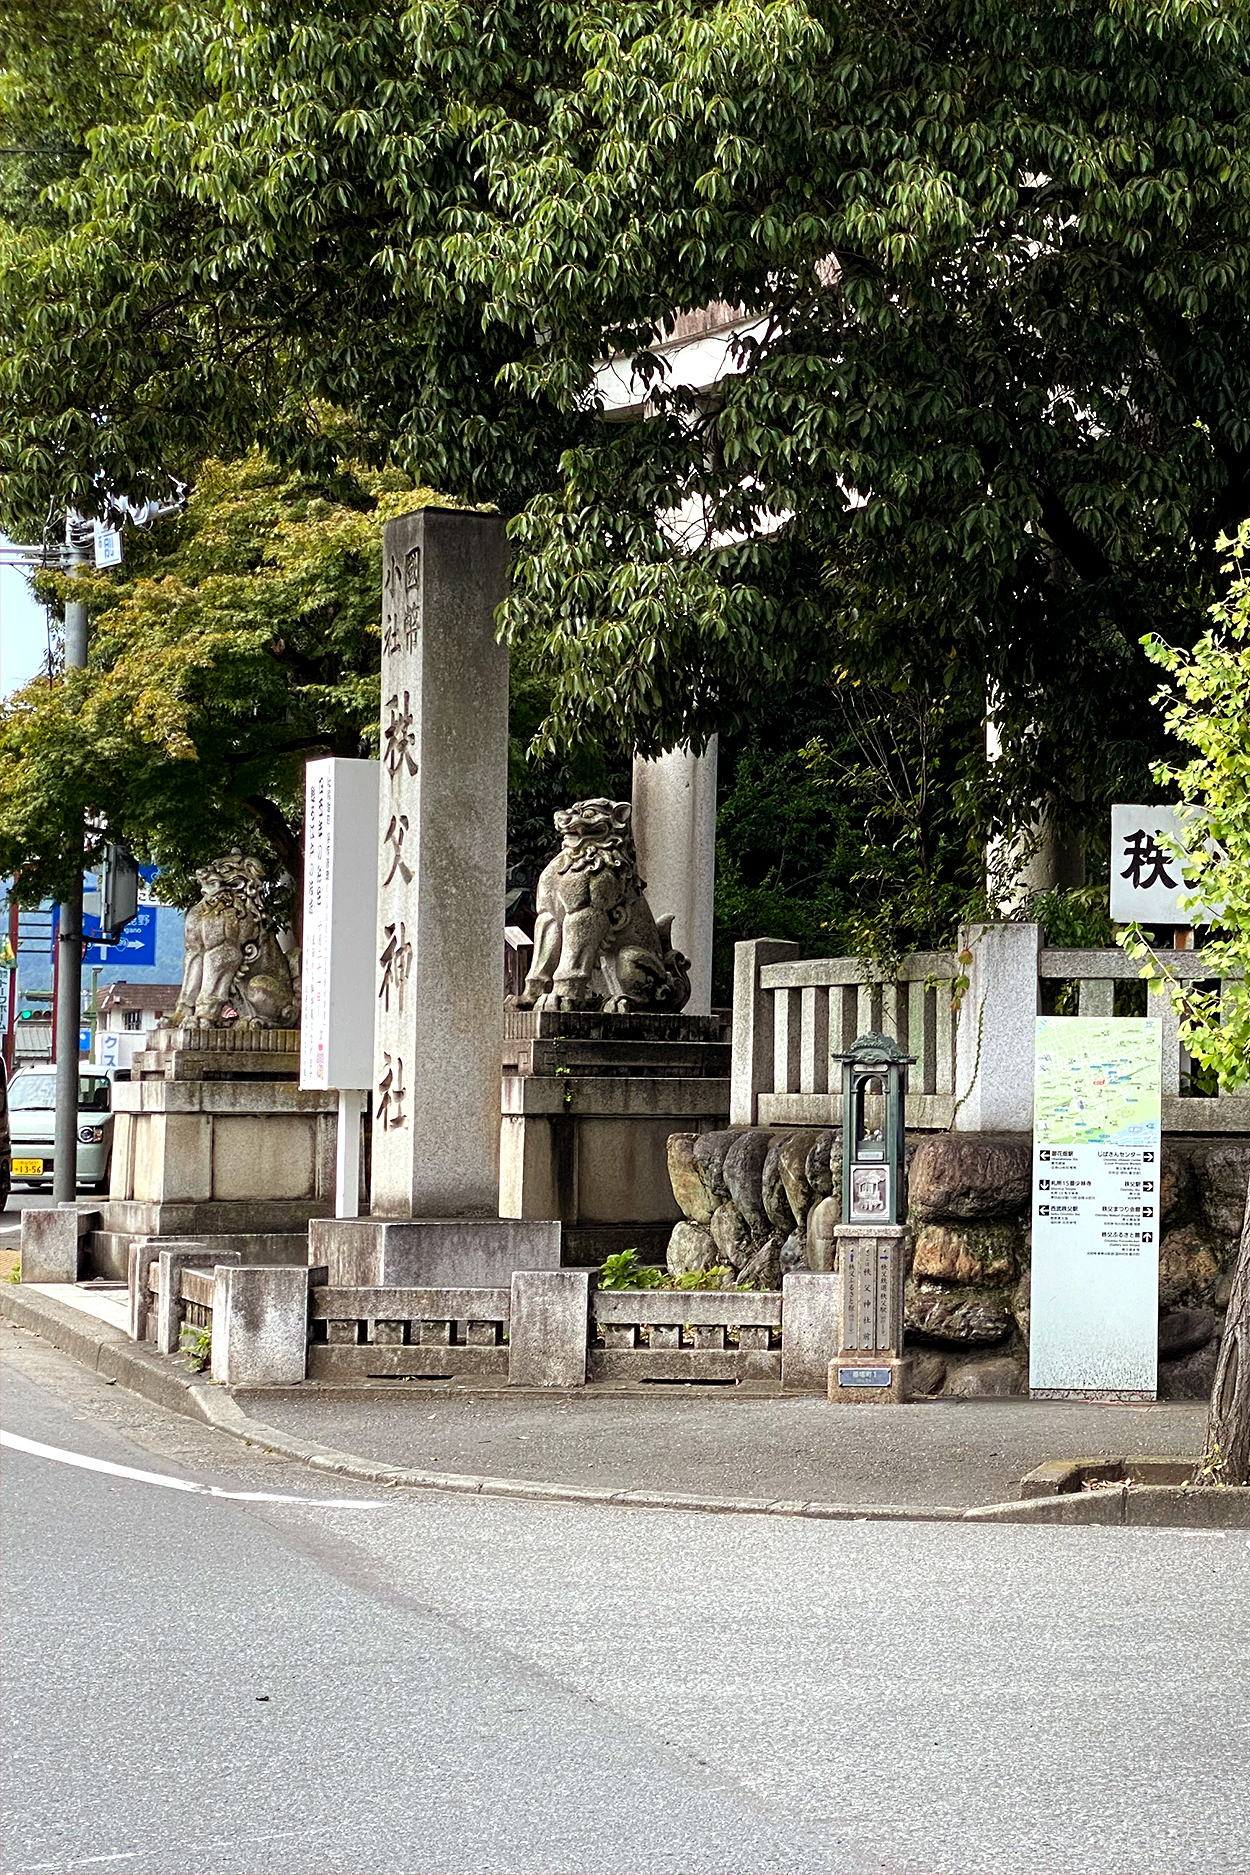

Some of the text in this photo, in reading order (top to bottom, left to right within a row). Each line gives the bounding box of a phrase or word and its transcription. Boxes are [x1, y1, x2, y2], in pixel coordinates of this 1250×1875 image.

[376, 690, 418, 1133] 秩父神社
[20, 1165, 42, 1174] 13-56
